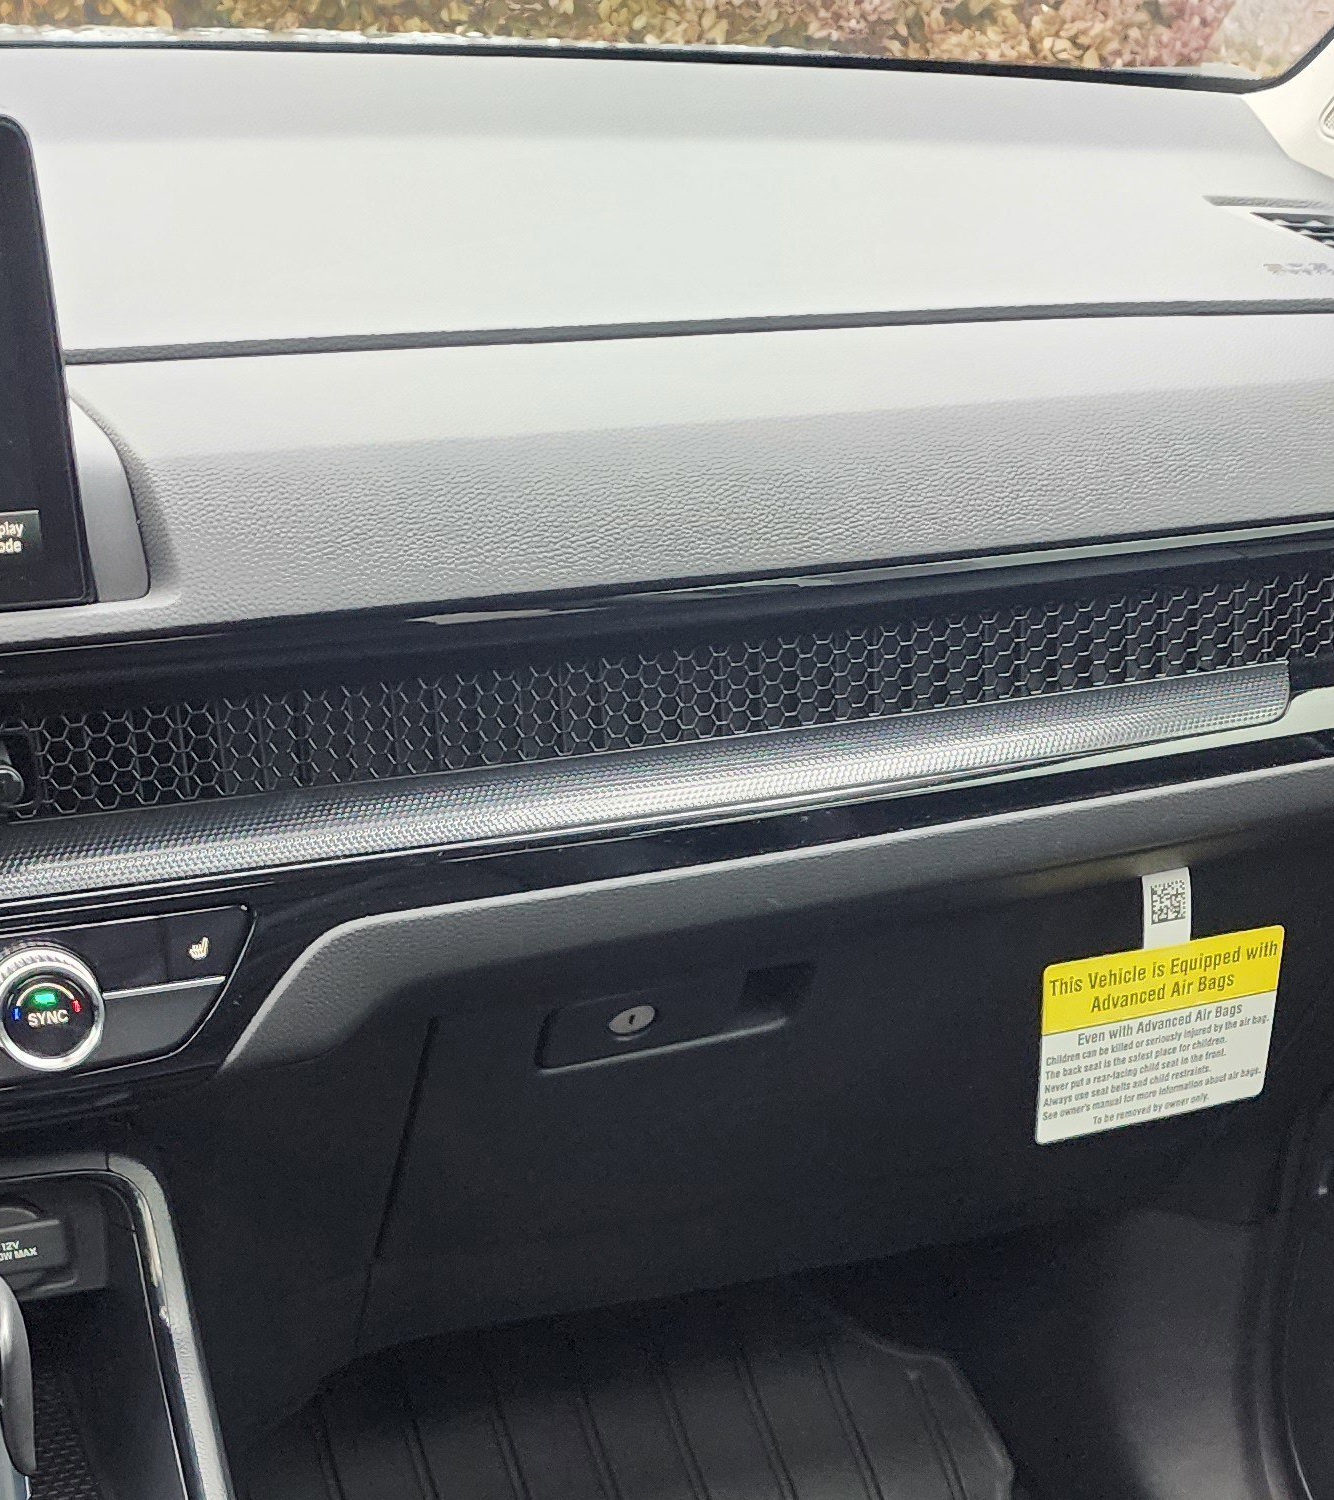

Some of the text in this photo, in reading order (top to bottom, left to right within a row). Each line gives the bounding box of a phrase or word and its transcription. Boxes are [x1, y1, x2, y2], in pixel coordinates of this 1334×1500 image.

[1049, 941, 1279, 997] This Vehicle is Equipped with
[1091, 973, 1235, 1013] Advanced Air Bags
[27, 1009, 69, 1029] SYNC
[1078, 1004, 1243, 1046] Even with Advanced Air Bags
[1046, 1052, 1081, 1067] Children
[1099, 1046, 1109, 1056] be
[1111, 1040, 1134, 1054] killed
[1044, 1083, 1069, 1094] Never
[1161, 1059, 1180, 1070] seat
[1045, 1070, 1061, 1080] The
[1063, 1065, 1082, 1077] back
[1083, 1061, 1102, 1072] seat
[1113, 1056, 1126, 1066] the
[1043, 1094, 1073, 1107] Always
[1091, 1086, 1109, 1098] seat
[1042, 1110, 1058, 1121] See
[0, 1240, 20, 1252] 12V
[13, 1247, 38, 1259] MAX
